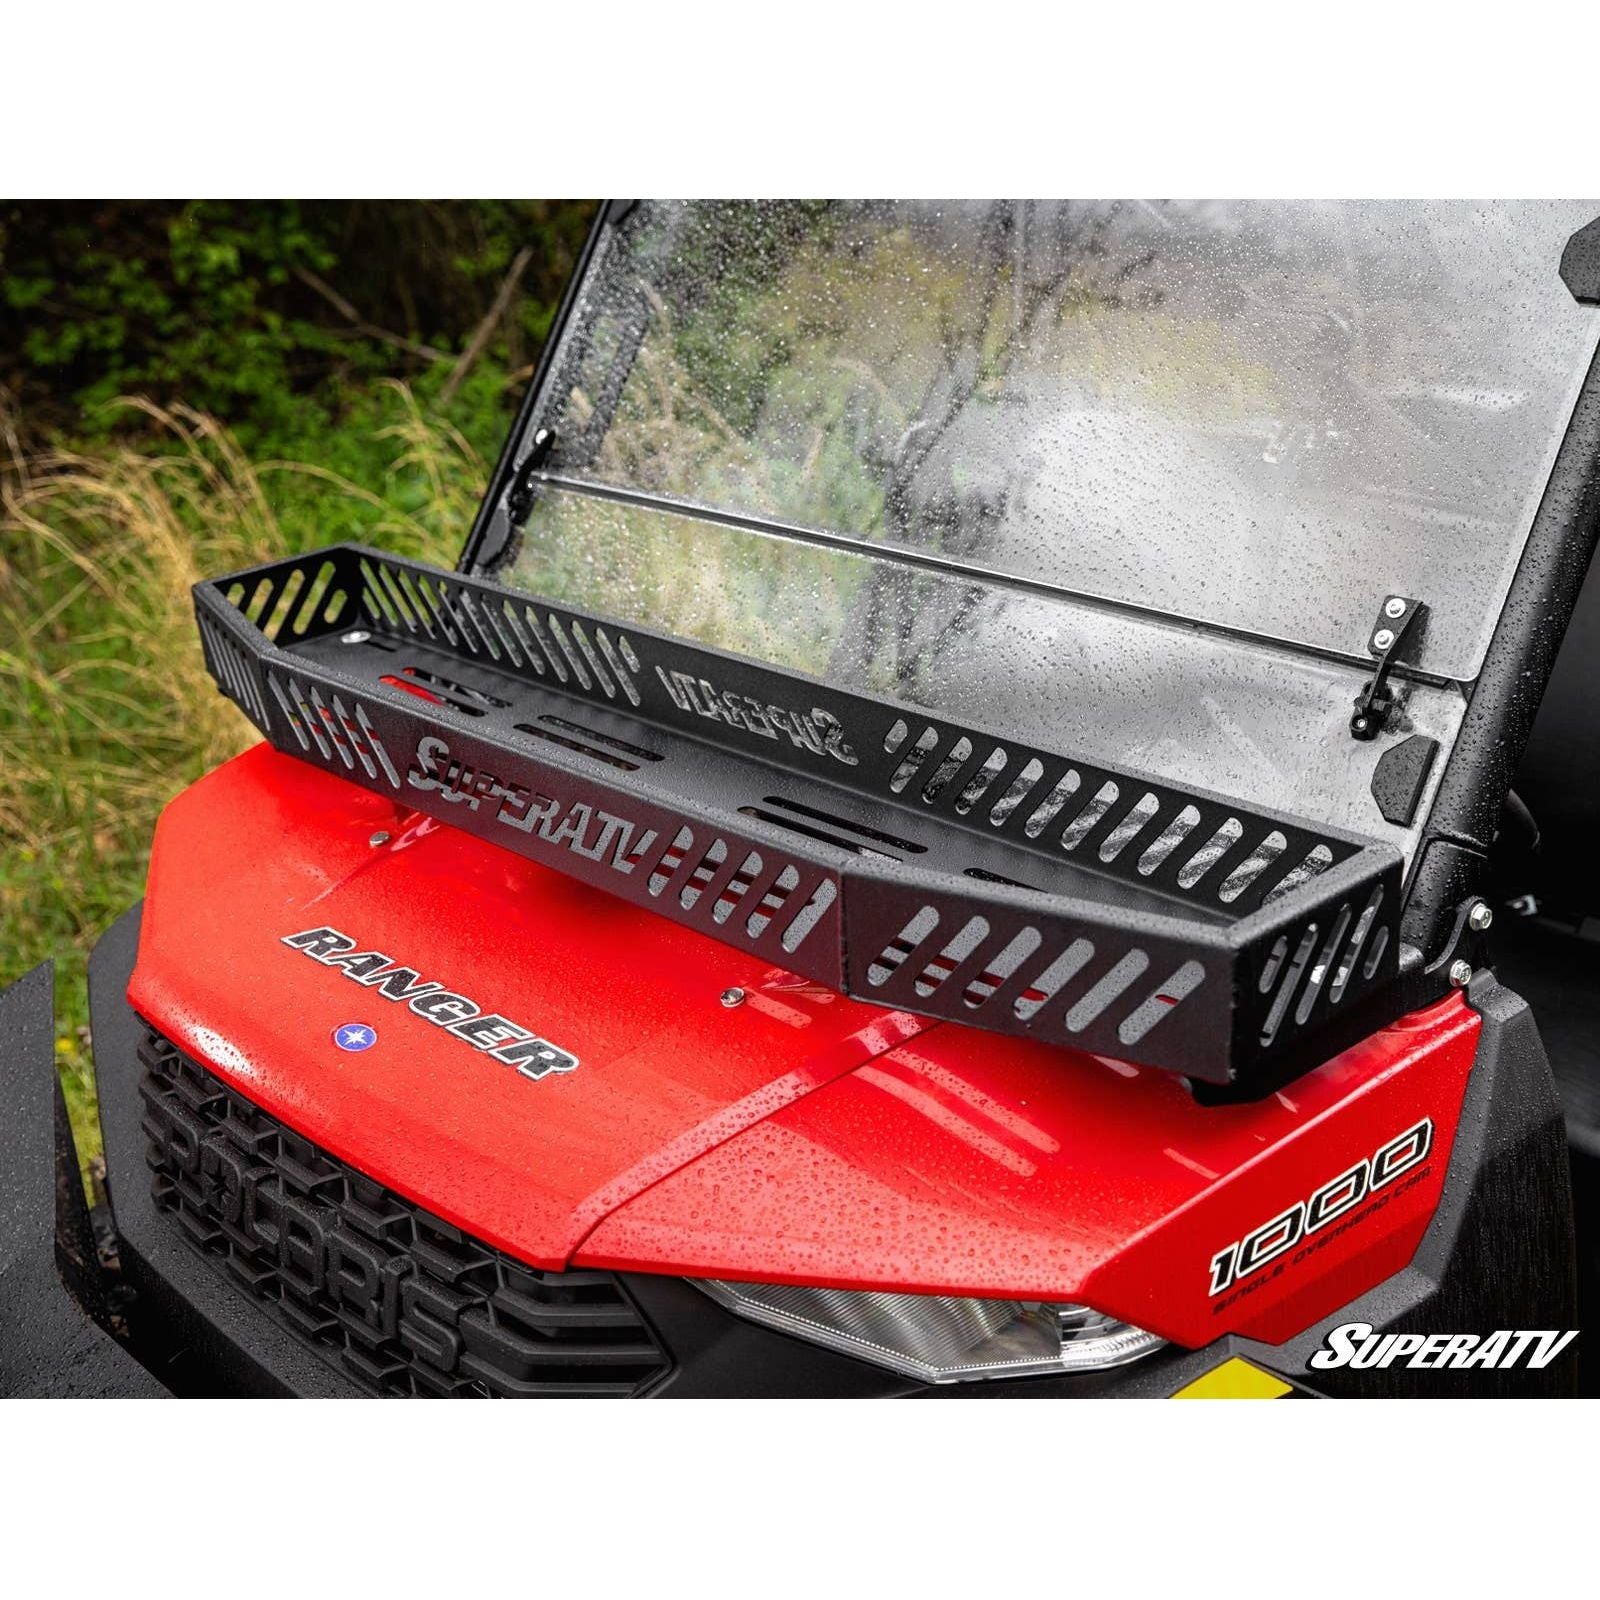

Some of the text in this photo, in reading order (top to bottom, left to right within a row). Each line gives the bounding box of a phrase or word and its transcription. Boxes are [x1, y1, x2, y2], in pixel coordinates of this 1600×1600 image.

[407, 736, 658, 874] SUPERATV
[280, 926, 580, 1081] RANGER
[157, 1099, 465, 1373] POLARIS
[1208, 1117, 1434, 1297] 1000
[1212, 1165, 1433, 1315] SINGLE OVERHEAD CAM
